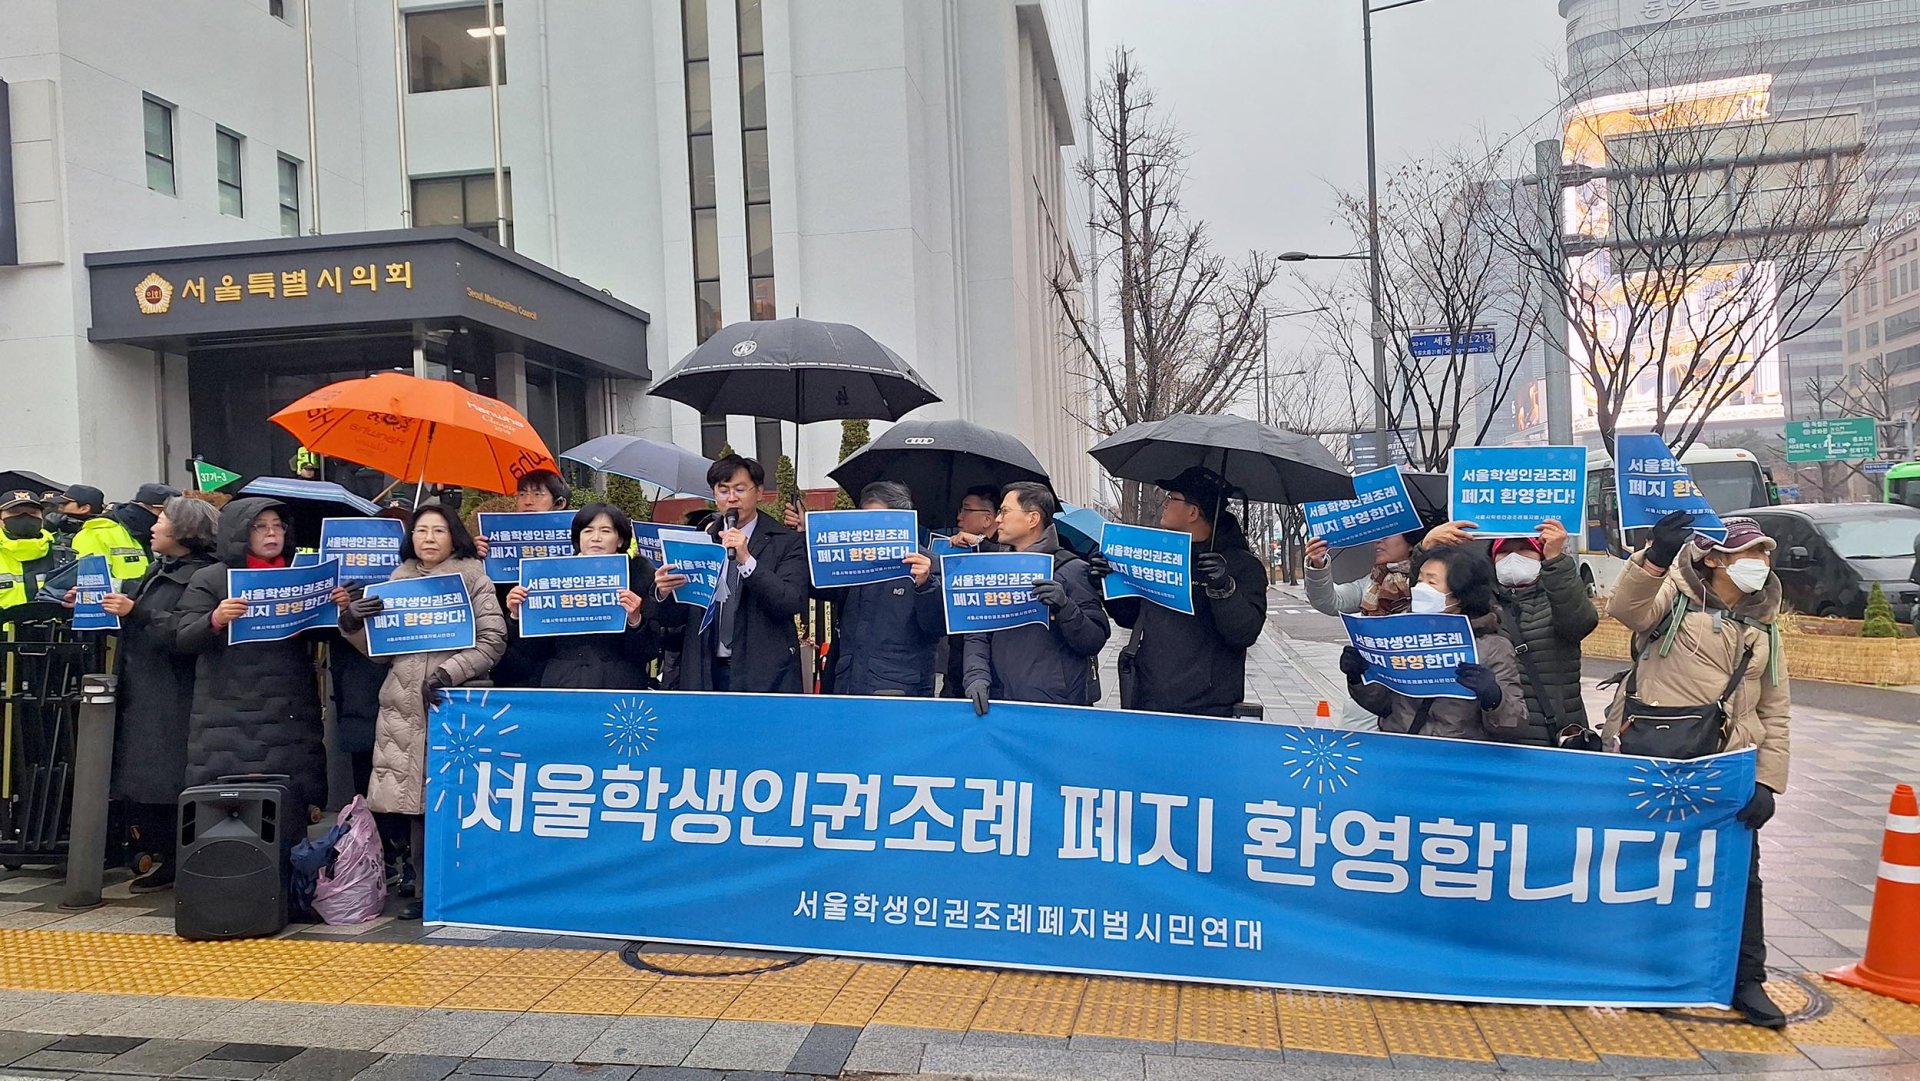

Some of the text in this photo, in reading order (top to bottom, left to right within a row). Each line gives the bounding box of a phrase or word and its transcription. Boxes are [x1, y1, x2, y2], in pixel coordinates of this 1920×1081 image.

[181, 261, 413, 304] 서울특별시의회
[1462, 468, 1577, 483] 서울학생인권조례
[1461, 488, 1577, 504] 폐지 환영한다!
[1628, 479, 1666, 498] 폐지
[1308, 485, 1399, 518] 서울학생인권조례
[1311, 501, 1406, 537] 폐지 환영한다!
[326, 536, 400, 548] 서울학생인권조례
[815, 529, 910, 544] 서울학생인권조례
[345, 553, 400, 567] 환영한다!
[490, 546, 517, 559] 폐지
[817, 548, 846, 563] 폐지
[1104, 543, 1183, 566] 서울학생인권조례
[527, 575, 621, 590] 서울학생인권조례
[1131, 564, 1183, 587] 환영한다!
[240, 577, 334, 600] 서울학생인권조례
[275, 593, 333, 617] 환영한다!
[382, 592, 464, 609] 울학생인권조례
[528, 592, 621, 610] 폐지 환영한다!
[952, 592, 981, 607] 폐지
[373, 609, 467, 629] 폐지 환영한다!
[1355, 632, 1465, 650] 서울학생인권조례
[461, 761, 1719, 910] 서울학생인권조례 폐지 환영합니다!
[793, 889, 1263, 952] 서울학생인권조례폐지범시민연대
